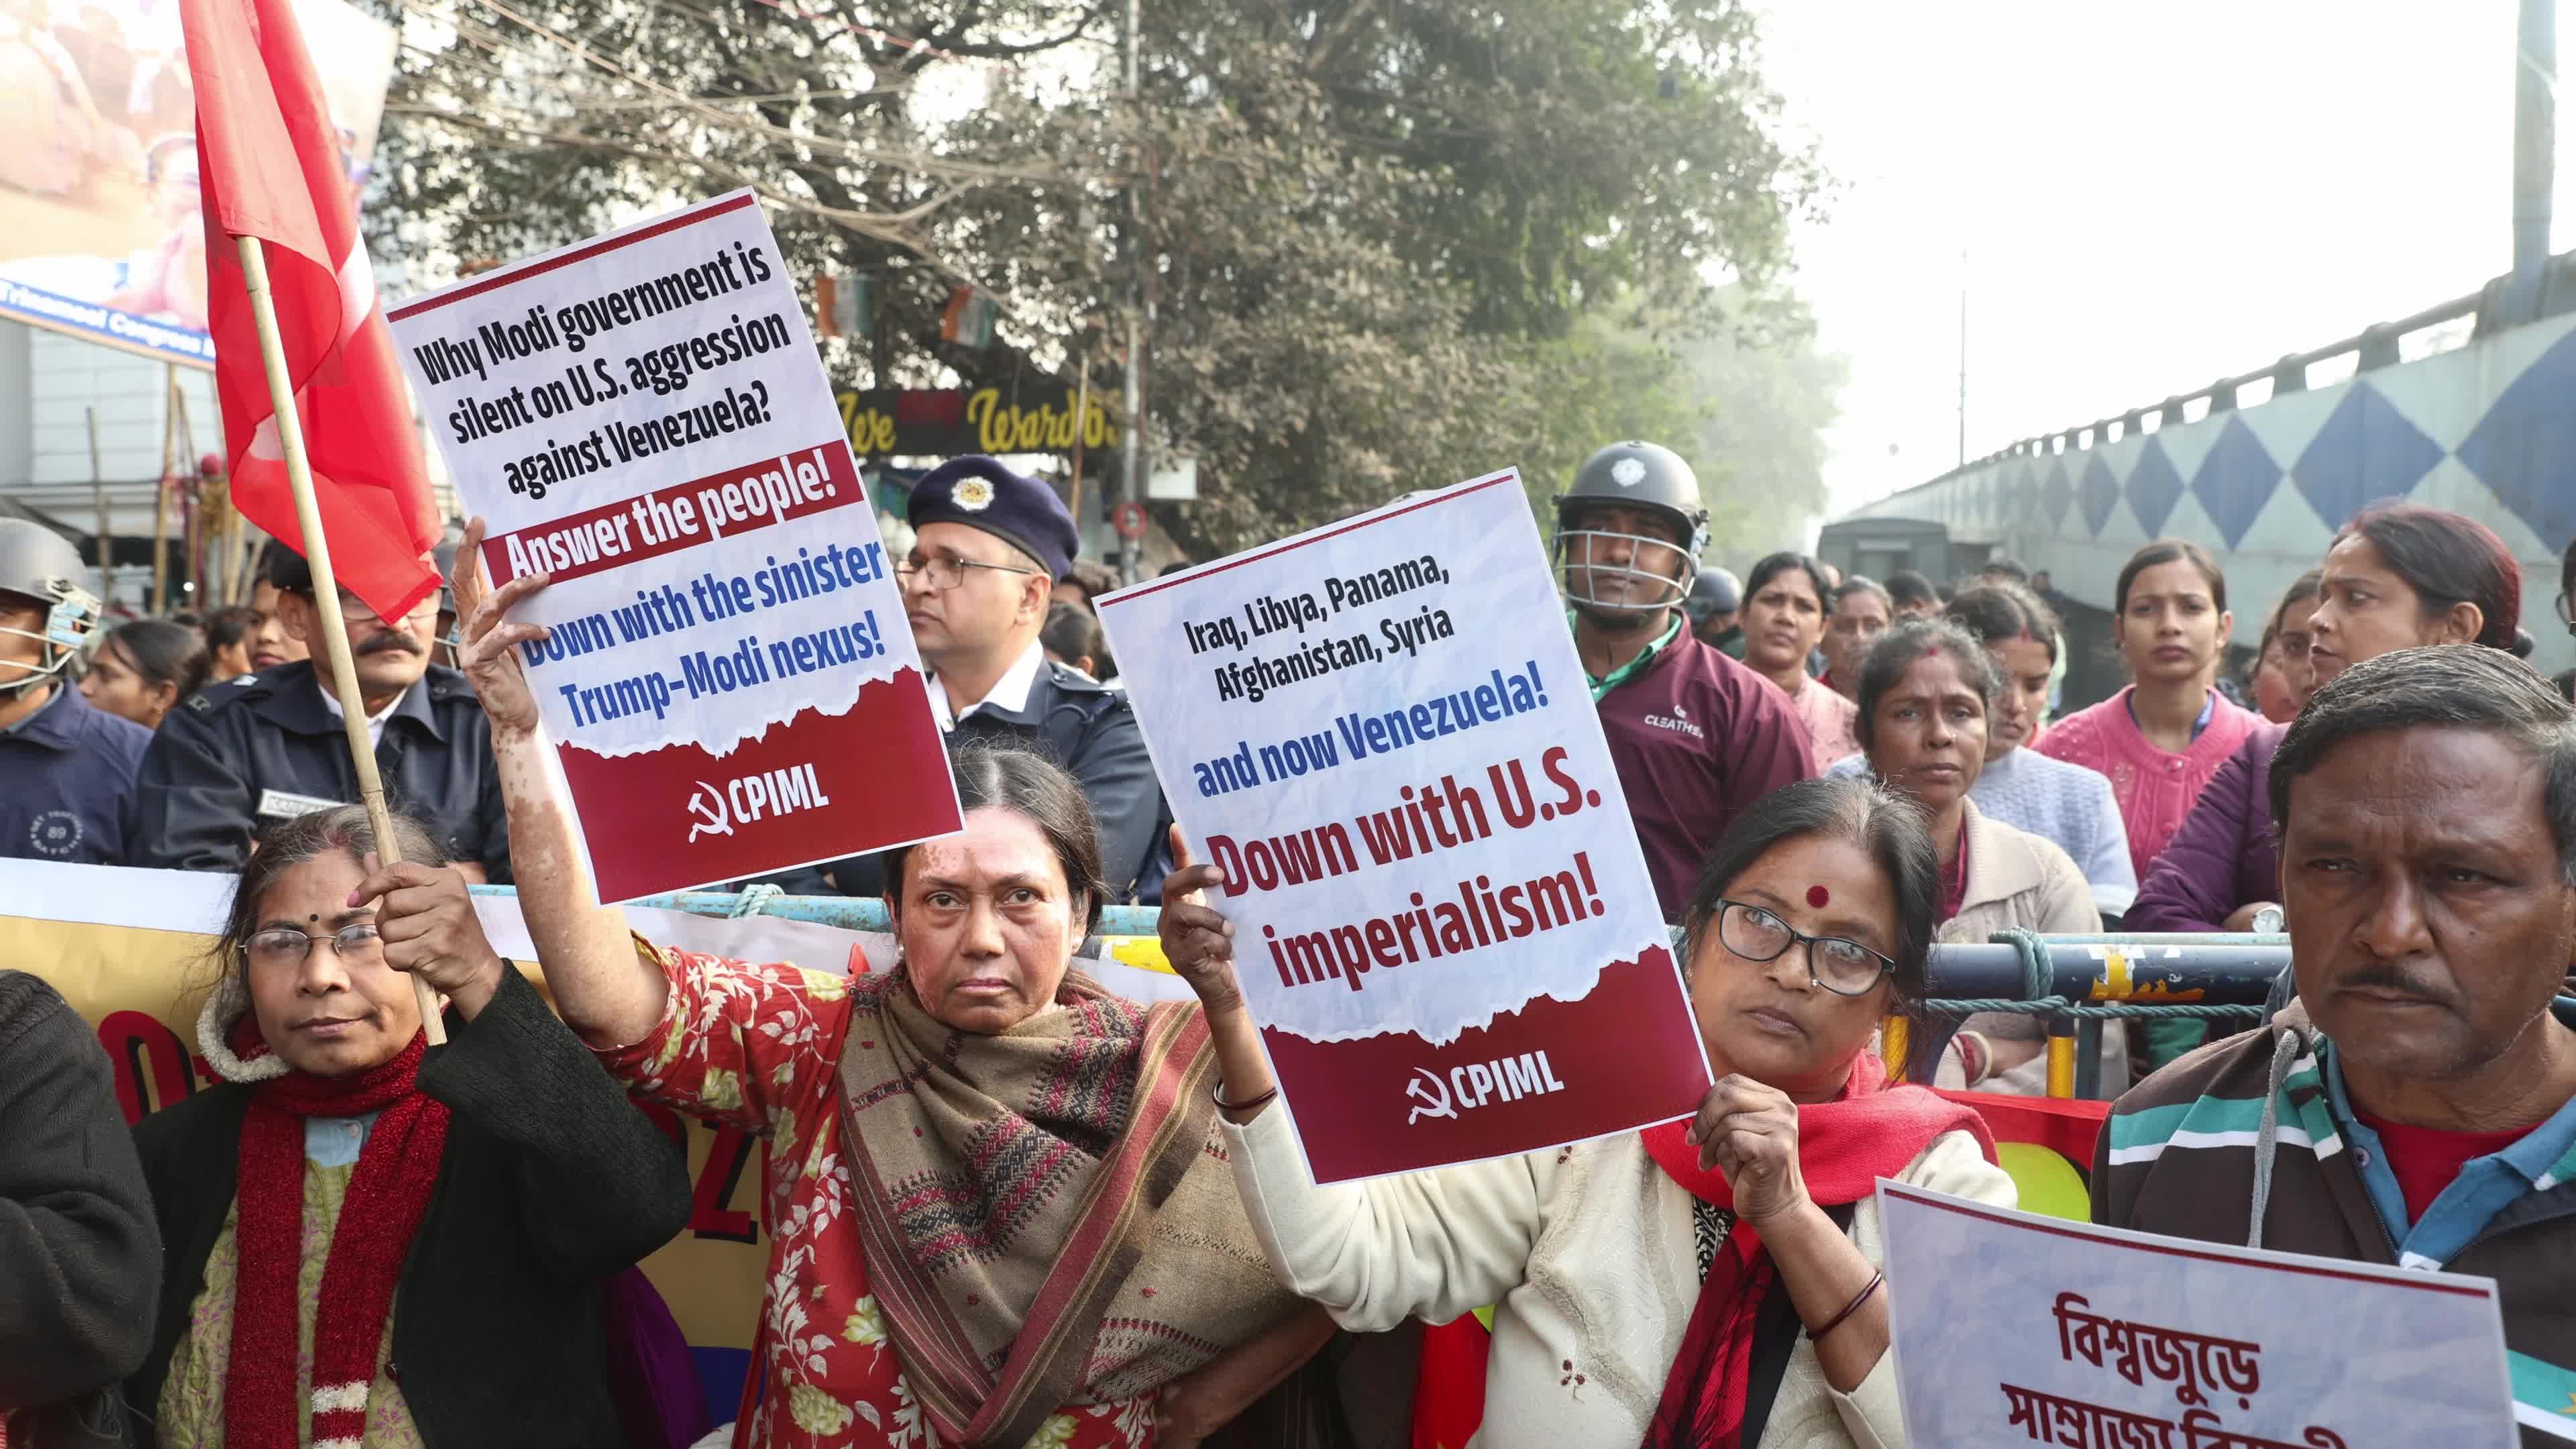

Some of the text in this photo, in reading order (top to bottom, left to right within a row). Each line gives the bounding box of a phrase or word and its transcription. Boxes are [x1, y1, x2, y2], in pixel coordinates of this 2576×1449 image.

[414, 241, 771, 385] Why Modi government is
[449, 313, 791, 443] silent on U.S. aggression
[967, 386, 1078, 453] Ward
[503, 379, 771, 500] against Venezuela?
[505, 447, 837, 580] Answer the people!
[521, 541, 884, 667] Down with the sinister
[1183, 555, 1450, 654] Iraq, Libya, Panama,
[1214, 607, 1454, 703] Afghanistan, Syria
[559, 609, 885, 728] Trump-Modi nexus!
[1193, 660, 1549, 798] and now Venezuela!
[728, 763, 829, 825] CPIML
[1205, 746, 1601, 898] Down with U.S.
[1262, 851, 1605, 991] imperialism!
[1450, 1050, 1565, 1110] CPIML
[2051, 1292, 2261, 1410] বিশ্বজুড়ে
